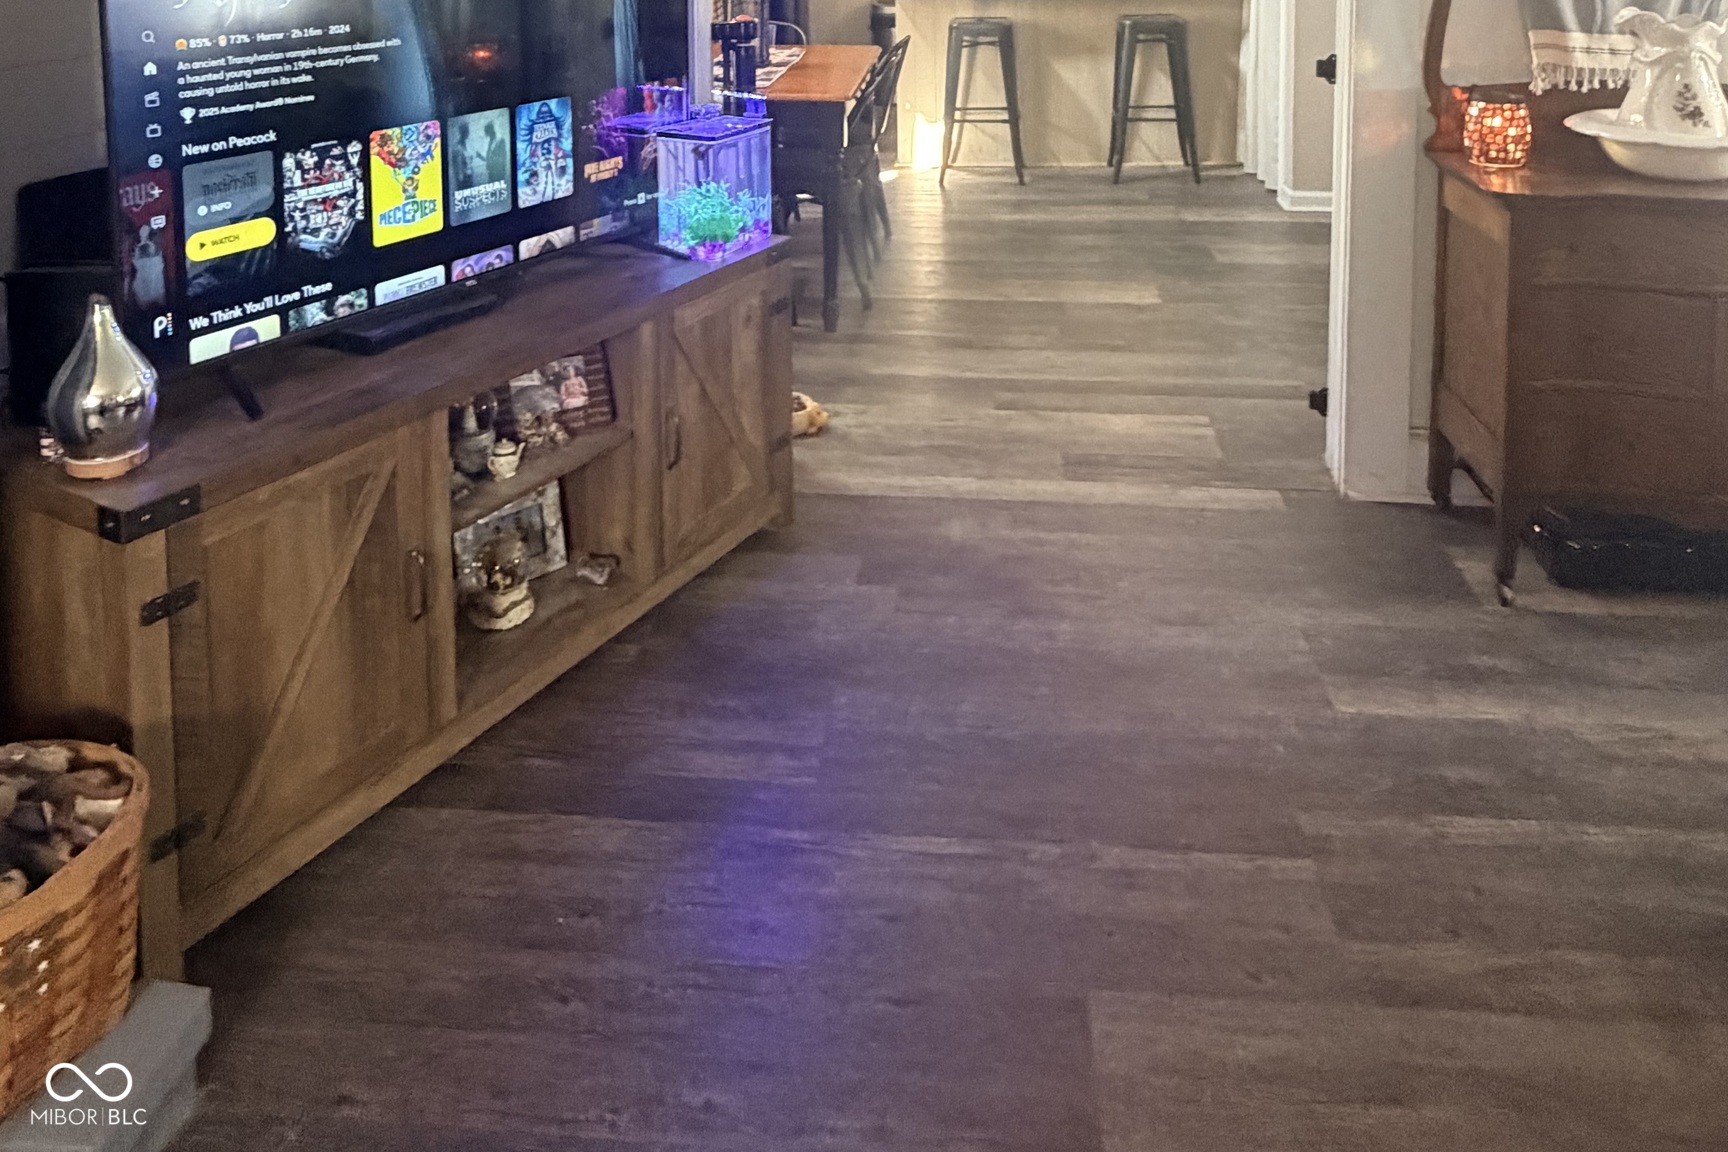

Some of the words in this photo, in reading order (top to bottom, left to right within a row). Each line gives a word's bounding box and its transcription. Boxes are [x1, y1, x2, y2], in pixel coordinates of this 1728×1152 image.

[229, 34, 251, 44] 73%
[256, 32, 284, 42] Horror
[177, 61, 191, 71] An
[191, 57, 226, 70] ancient
[224, 69, 252, 81] young
[178, 87, 214, 99] causing
[181, 143, 210, 157] New
[211, 140, 227, 151] on
[228, 129, 277, 148] Peacock
[454, 179, 507, 199] UNUSUAL
[210, 201, 232, 213] INFO
[210, 234, 240, 246] WATCH
[188, 315, 209, 330] We
[210, 305, 244, 324] Think
[244, 295, 273, 314] You'll
[274, 290, 301, 306] Love
[301, 282, 333, 298] These
